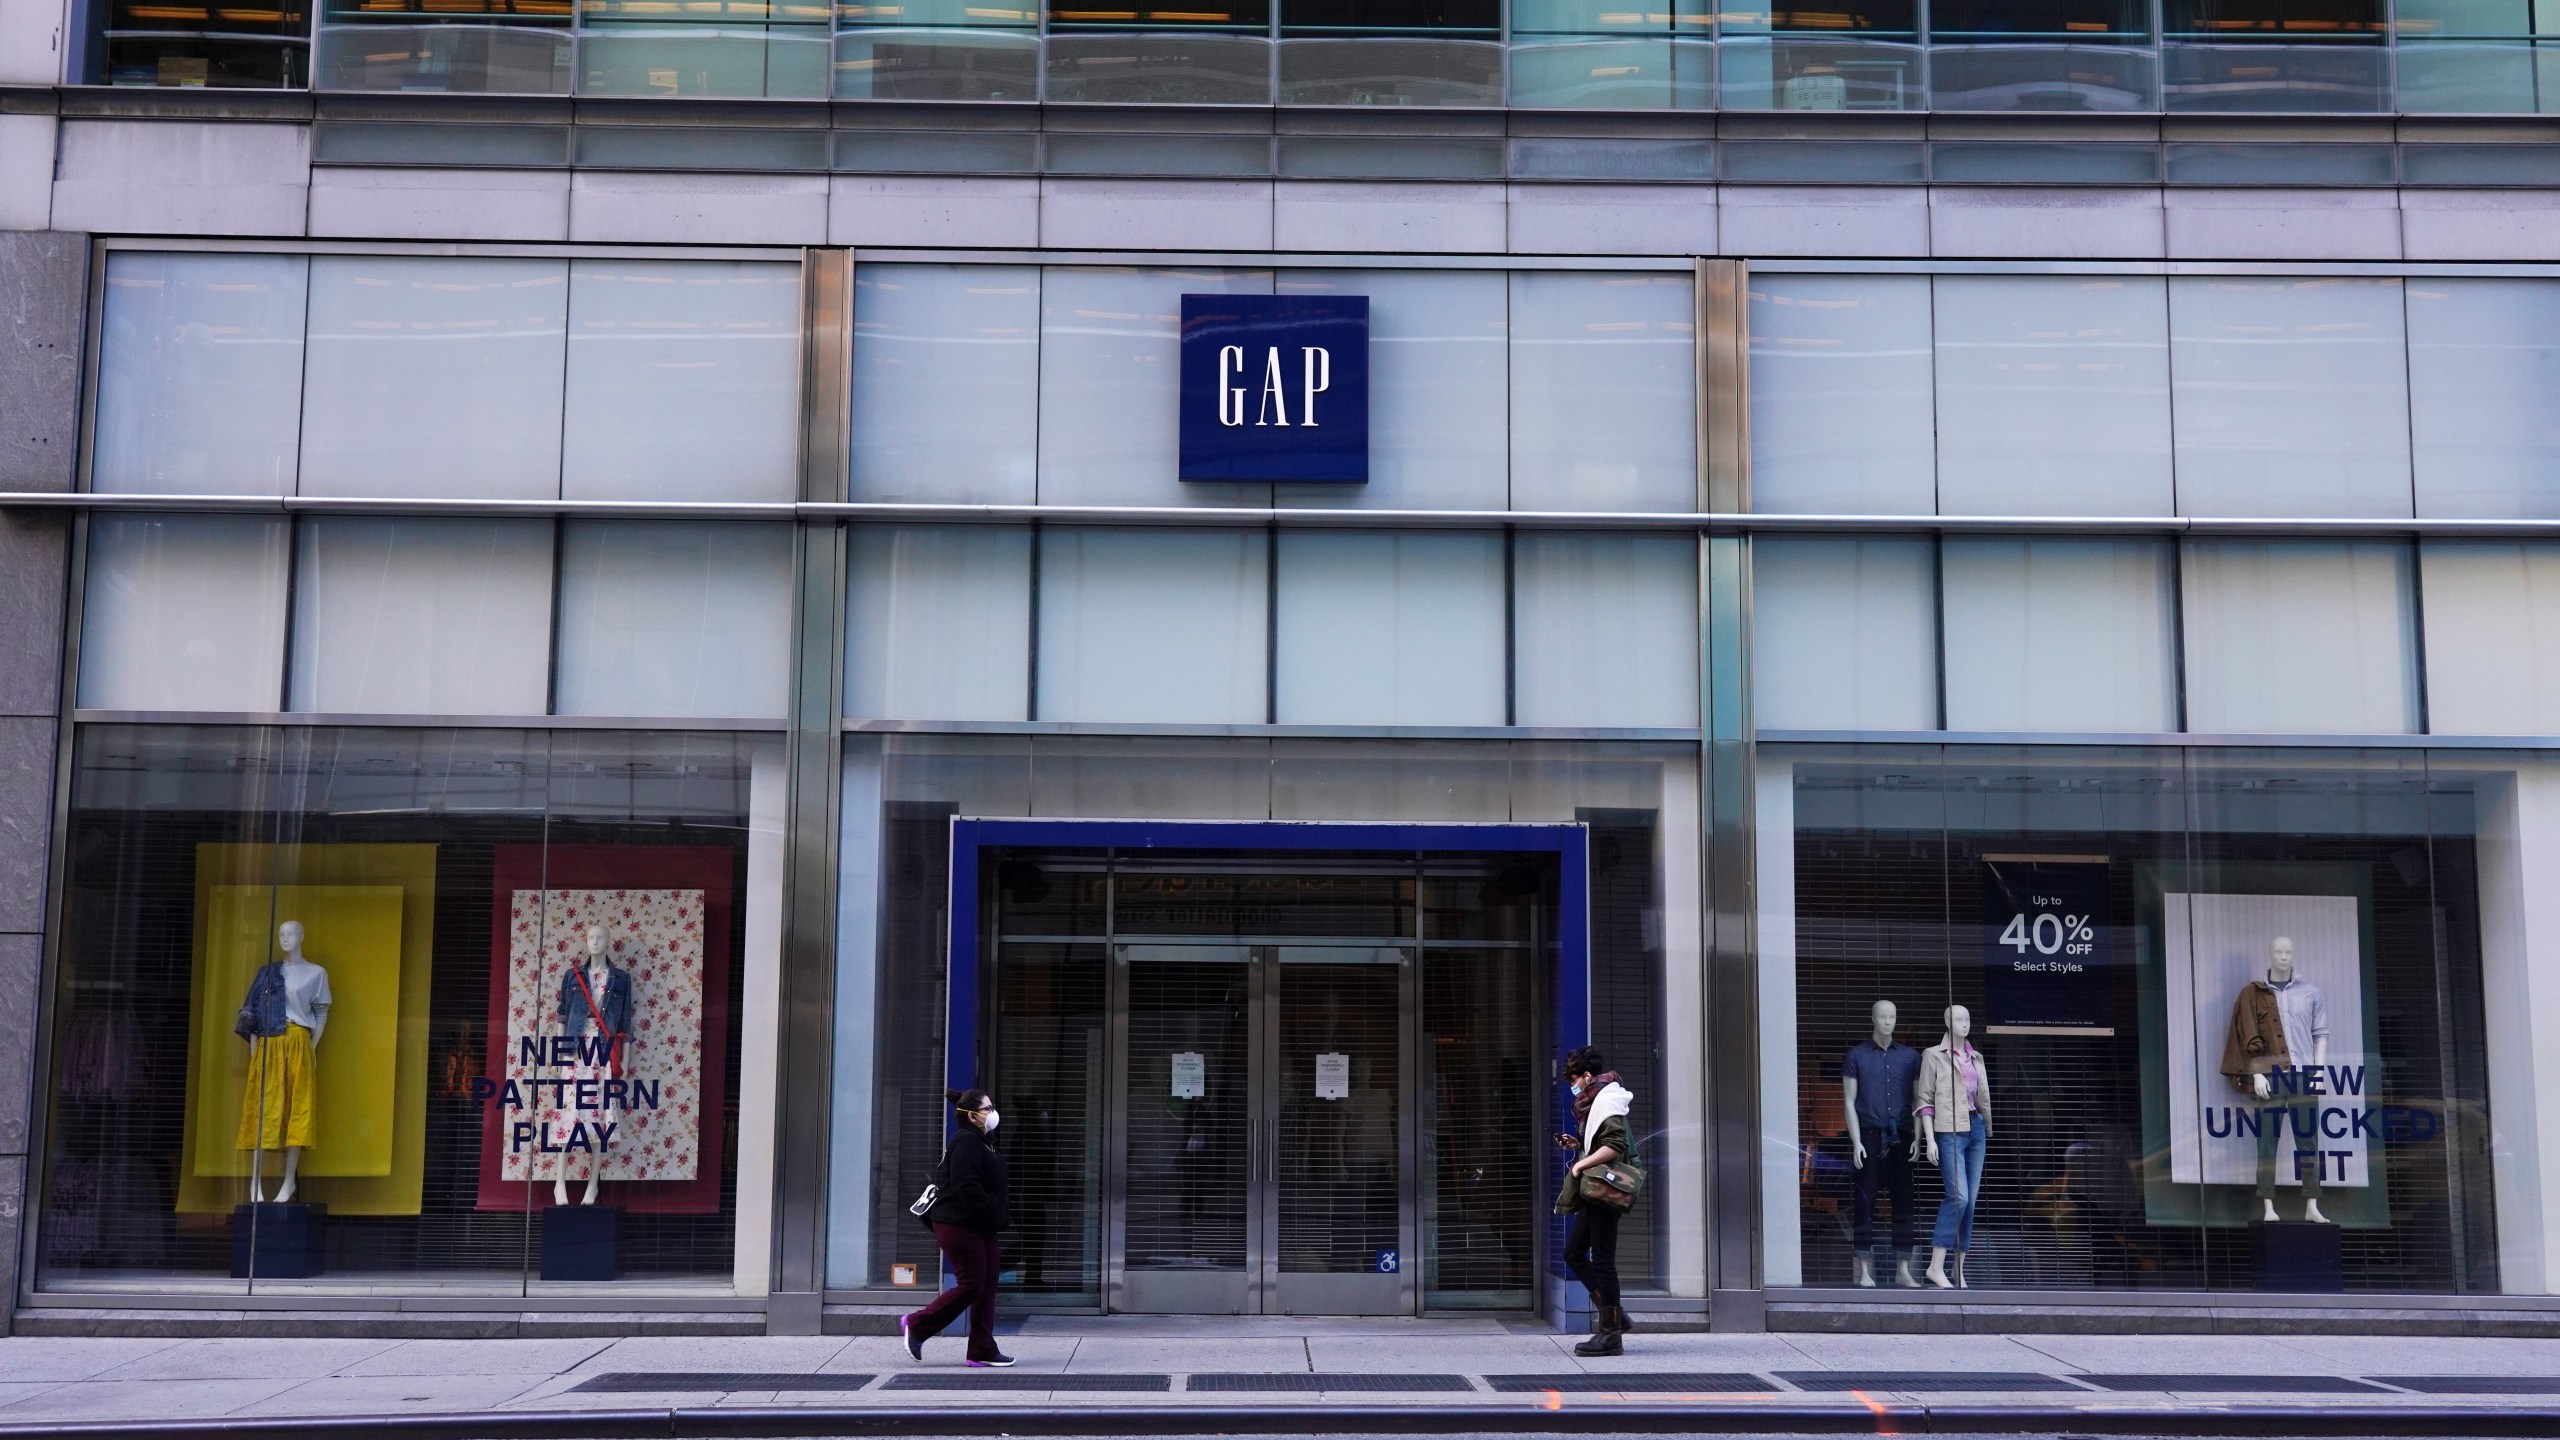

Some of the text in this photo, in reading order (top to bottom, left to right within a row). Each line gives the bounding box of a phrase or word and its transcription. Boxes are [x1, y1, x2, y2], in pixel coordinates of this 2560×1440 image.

[1219, 345, 1330, 427] GAP
[2032, 895, 2062, 907] Up to
[1999, 913, 2094, 955] 40% OFF
[2013, 961, 2083, 974] Select Styles
[520, 1036, 616, 1067] NEW
[471, 1079, 659, 1110] PATTERN
[2271, 1064, 2366, 1096] NEW
[512, 1122, 618, 1153] PLAY
[2205, 1107, 2438, 1142] UNTUCKED
[2293, 1150, 2353, 1182] FIT
